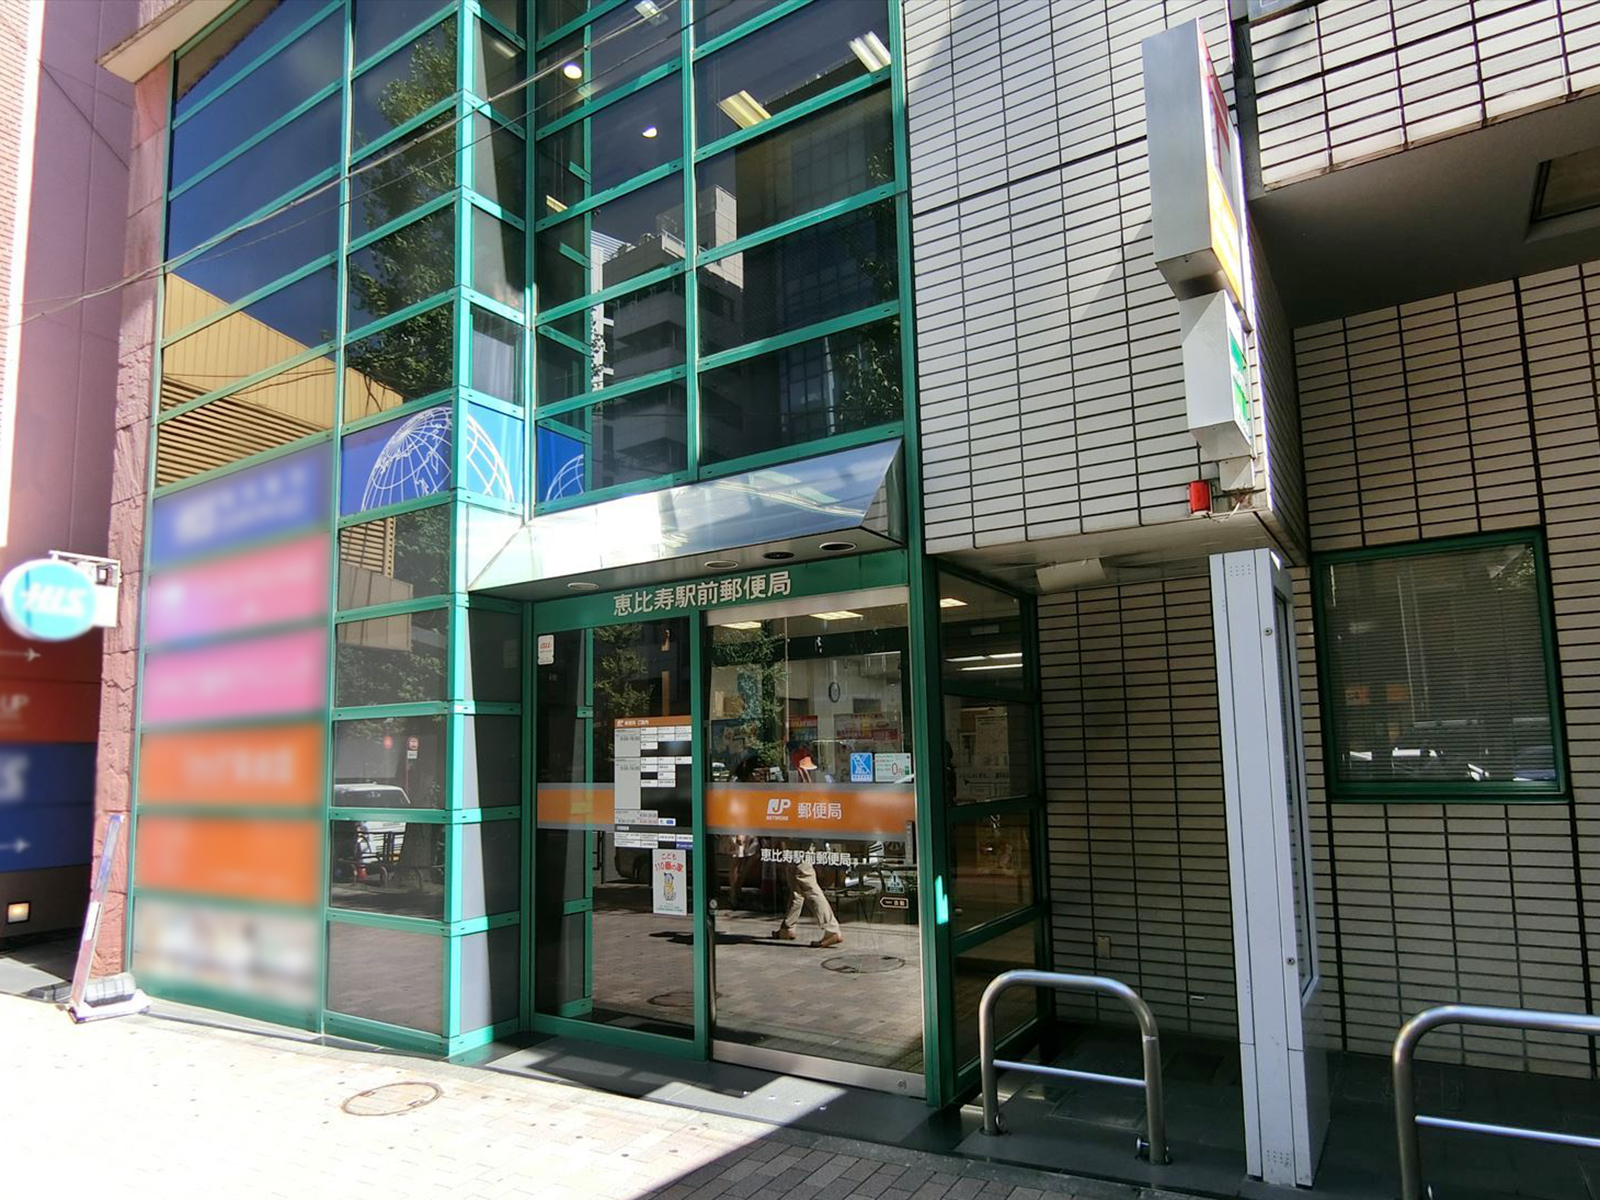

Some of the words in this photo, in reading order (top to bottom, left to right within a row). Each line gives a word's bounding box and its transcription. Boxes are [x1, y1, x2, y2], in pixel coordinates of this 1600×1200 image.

[613, 570, 791, 617] 恵比寿駅前郵便局
[798, 802, 842, 820] 郵便局
[661, 852, 677, 861] こども
[761, 848, 851, 867] 恵比寿駅前郵便局
